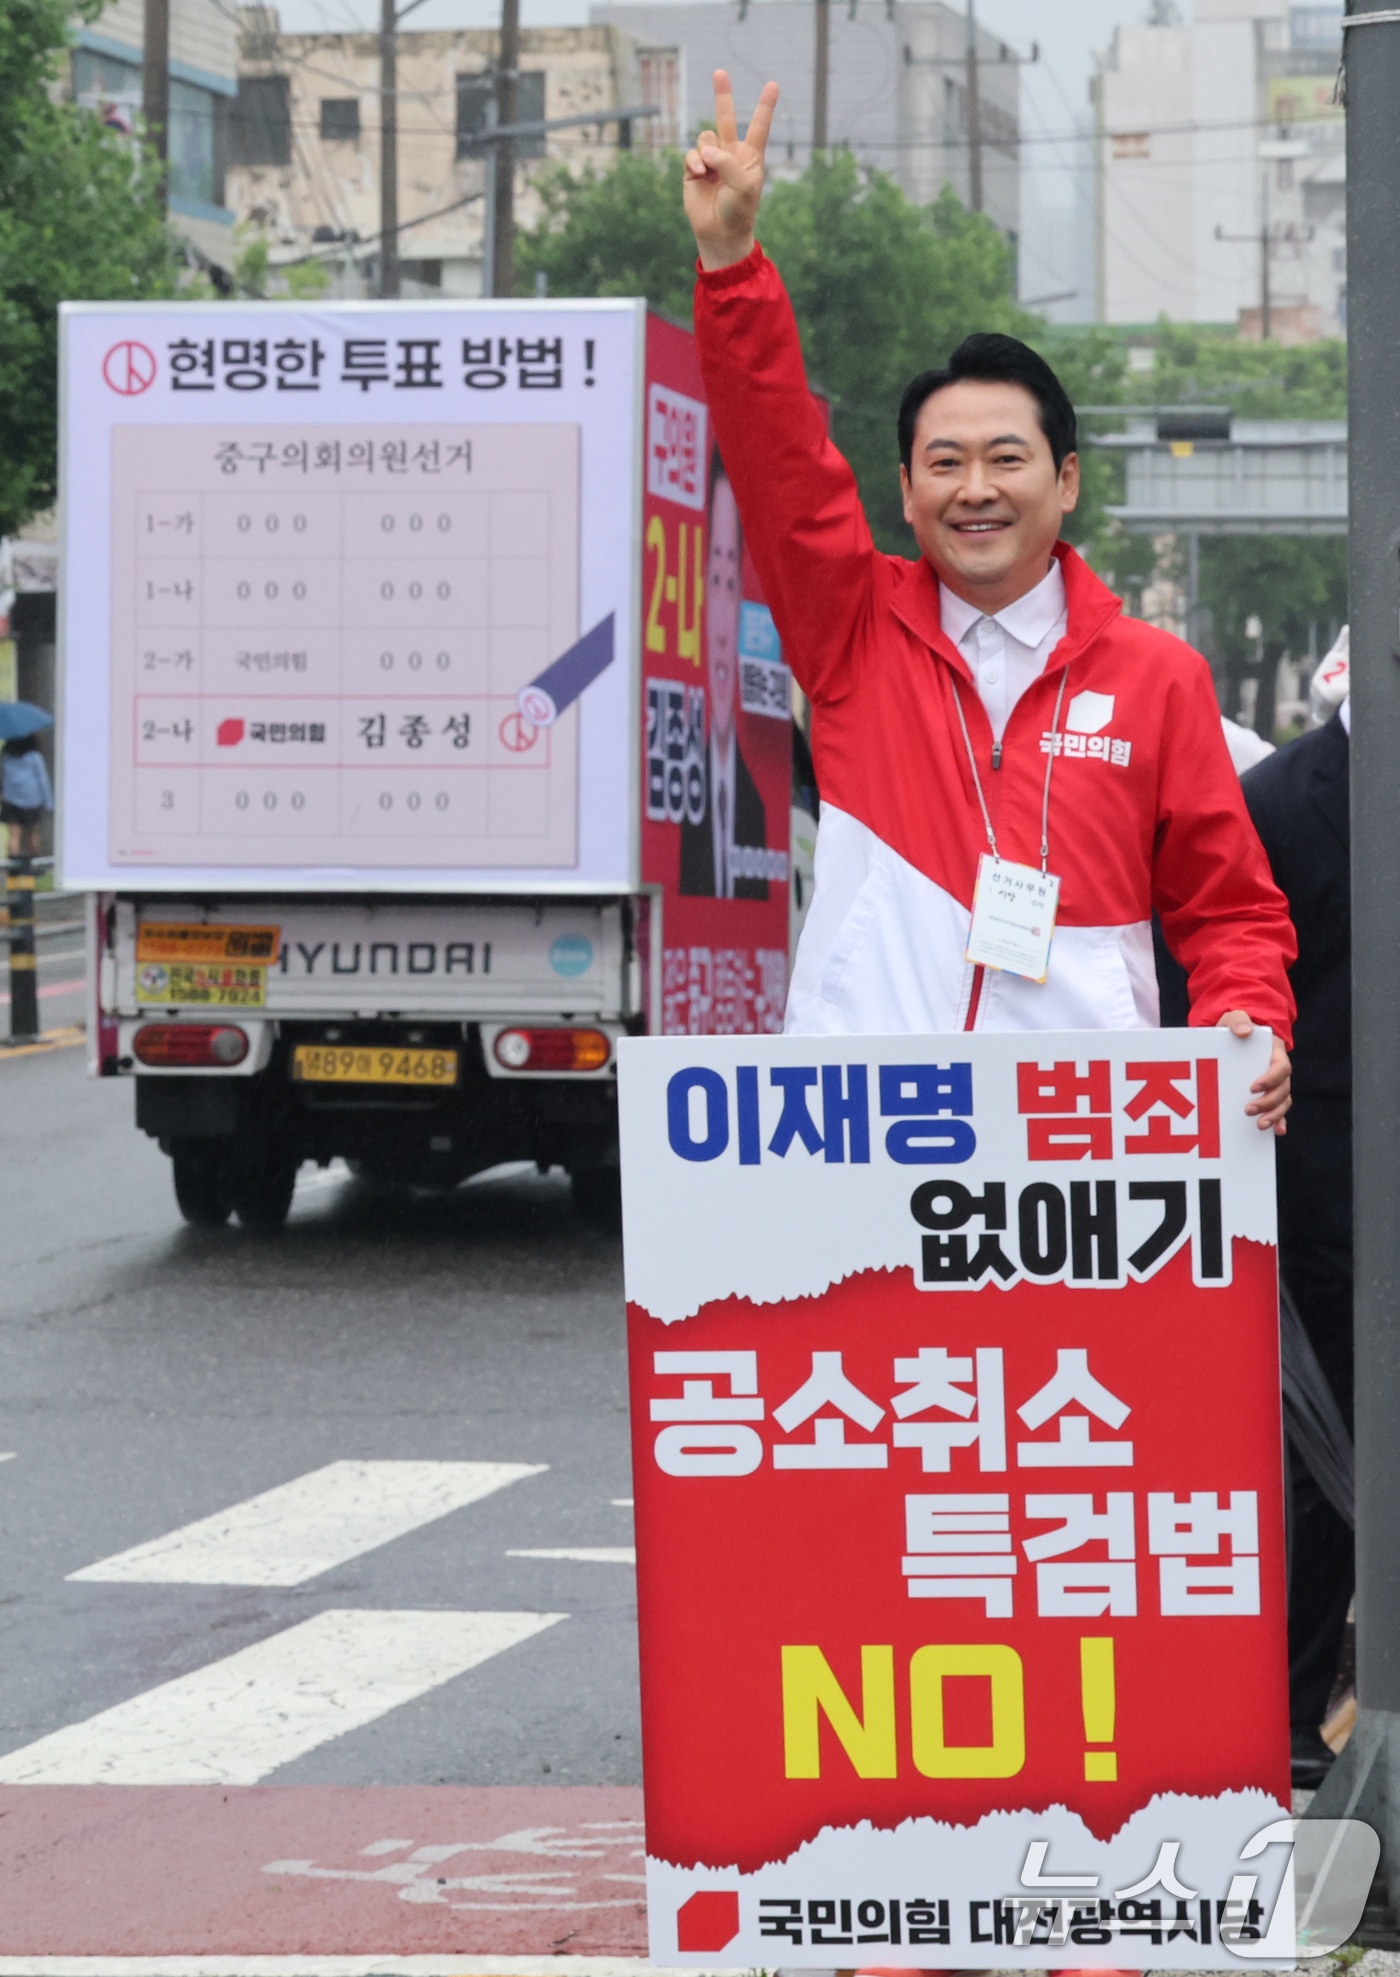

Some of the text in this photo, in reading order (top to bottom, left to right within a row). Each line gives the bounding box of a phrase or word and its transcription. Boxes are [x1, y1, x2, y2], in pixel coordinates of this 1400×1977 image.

[168, 338, 325, 391] 현명한
[341, 338, 443, 393] 투표
[463, 337, 563, 390] 방법
[213, 439, 475, 475] 중구의회의원선거
[646, 514, 703, 668] 2-나
[1322, 661, 1347, 684] 2
[142, 718, 194, 743] 2-나
[249, 722, 325, 743] 국민의힘
[646, 678, 706, 825] 김종성
[1039, 731, 1132, 767] 국민의힘
[992, 873, 1046, 898] 선거사무원
[379, 1052, 447, 1079] 9468
[667, 1058, 1221, 1165] 이재명 범죄
[909, 1179, 1224, 1283] 없애기
[649, 1347, 1133, 1477] 공소취소
[901, 1490, 1261, 1618] 특검법
[781, 1644, 1026, 1779] NO
[758, 1899, 1265, 1946] 국민의힘 대전광역시당
